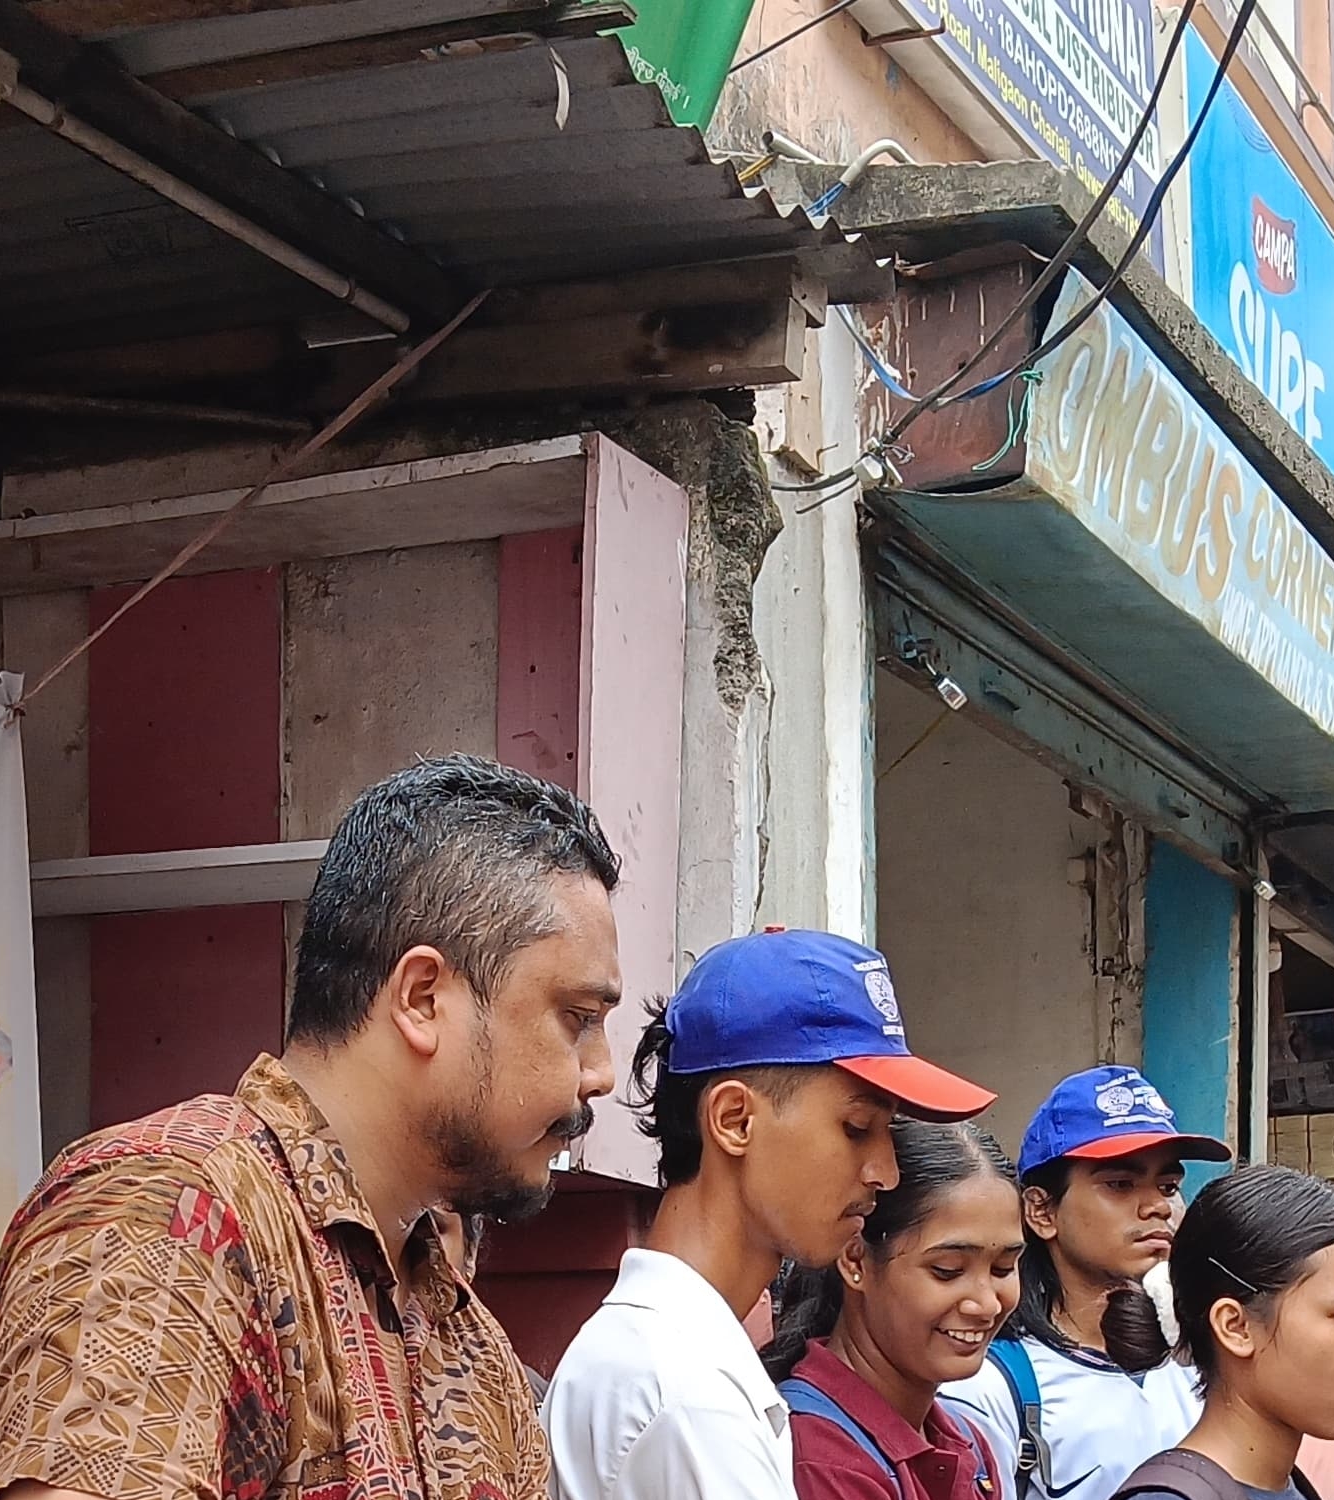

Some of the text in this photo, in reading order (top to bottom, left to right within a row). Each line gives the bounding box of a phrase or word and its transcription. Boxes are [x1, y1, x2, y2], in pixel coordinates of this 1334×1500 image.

[977, 37, 1029, 118] Maligaon
[1255, 214, 1296, 281] CAMPA
[1220, 583, 1256, 653] HOME
[1248, 611, 1315, 714] APPLIANCE
